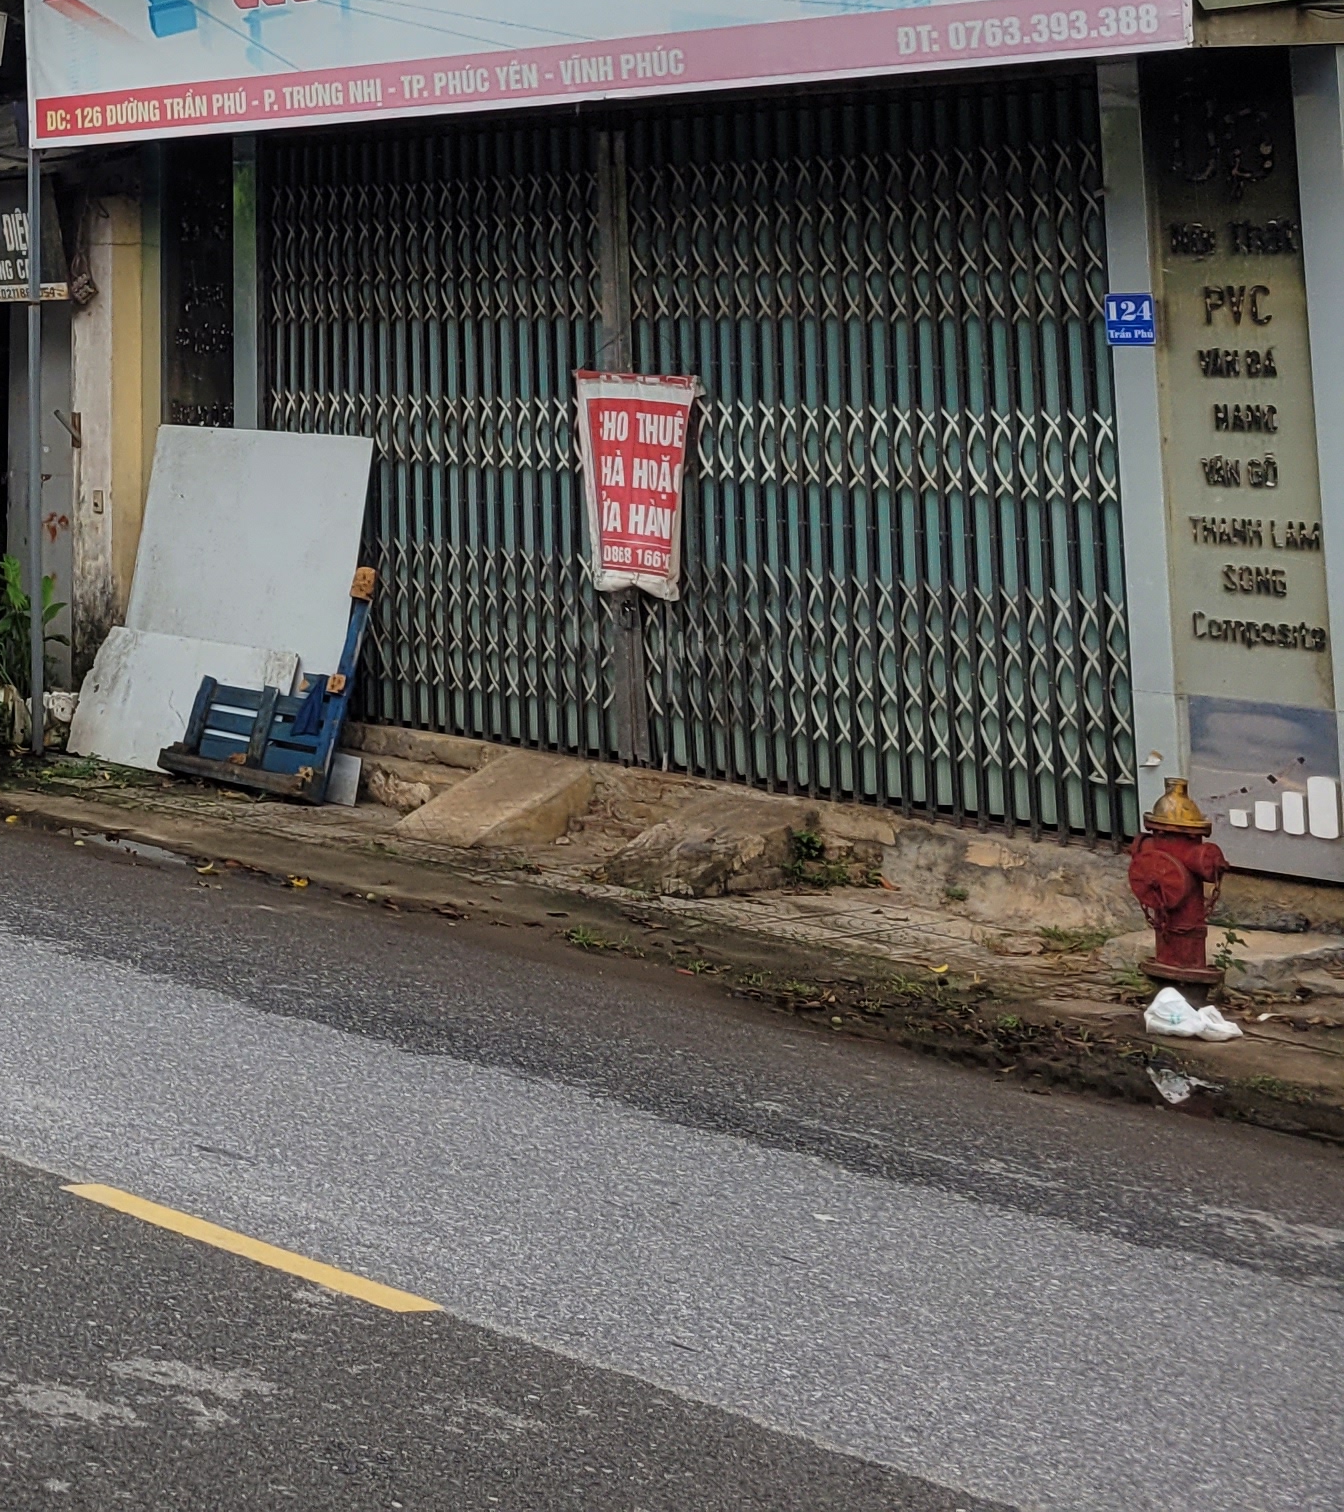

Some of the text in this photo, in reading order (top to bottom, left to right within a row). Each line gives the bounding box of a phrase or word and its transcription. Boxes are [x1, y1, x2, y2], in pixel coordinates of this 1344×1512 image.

[897, 2, 1159, 55] ĐT: 0763.393.388
[46, 110, 72, 132] ĐC:
[75, 107, 103, 128] 126
[106, 97, 160, 125] ĐƯỜNG
[164, 89, 208, 120] TRẦN
[213, 87, 246, 115] PHÚ
[264, 92, 279, 112] P.
[282, 80, 343, 109] TRƯNG
[349, 78, 383, 107] NHỊ
[400, 74, 429, 100] TP.
[433, 64, 490, 96] PHÚC
[495, 60, 540, 90] YÊN
[559, 54, 614, 85] VĨNH
[620, 45, 685, 80] PHÚC
[1107, 300, 1153, 322] 124
[1203, 284, 1273, 326] PVC
[1133, 328, 1154, 339] Phú
[599, 409, 685, 448] HO THUÊ
[628, 498, 676, 539] HÀN
[1192, 609, 1327, 652] Composite
